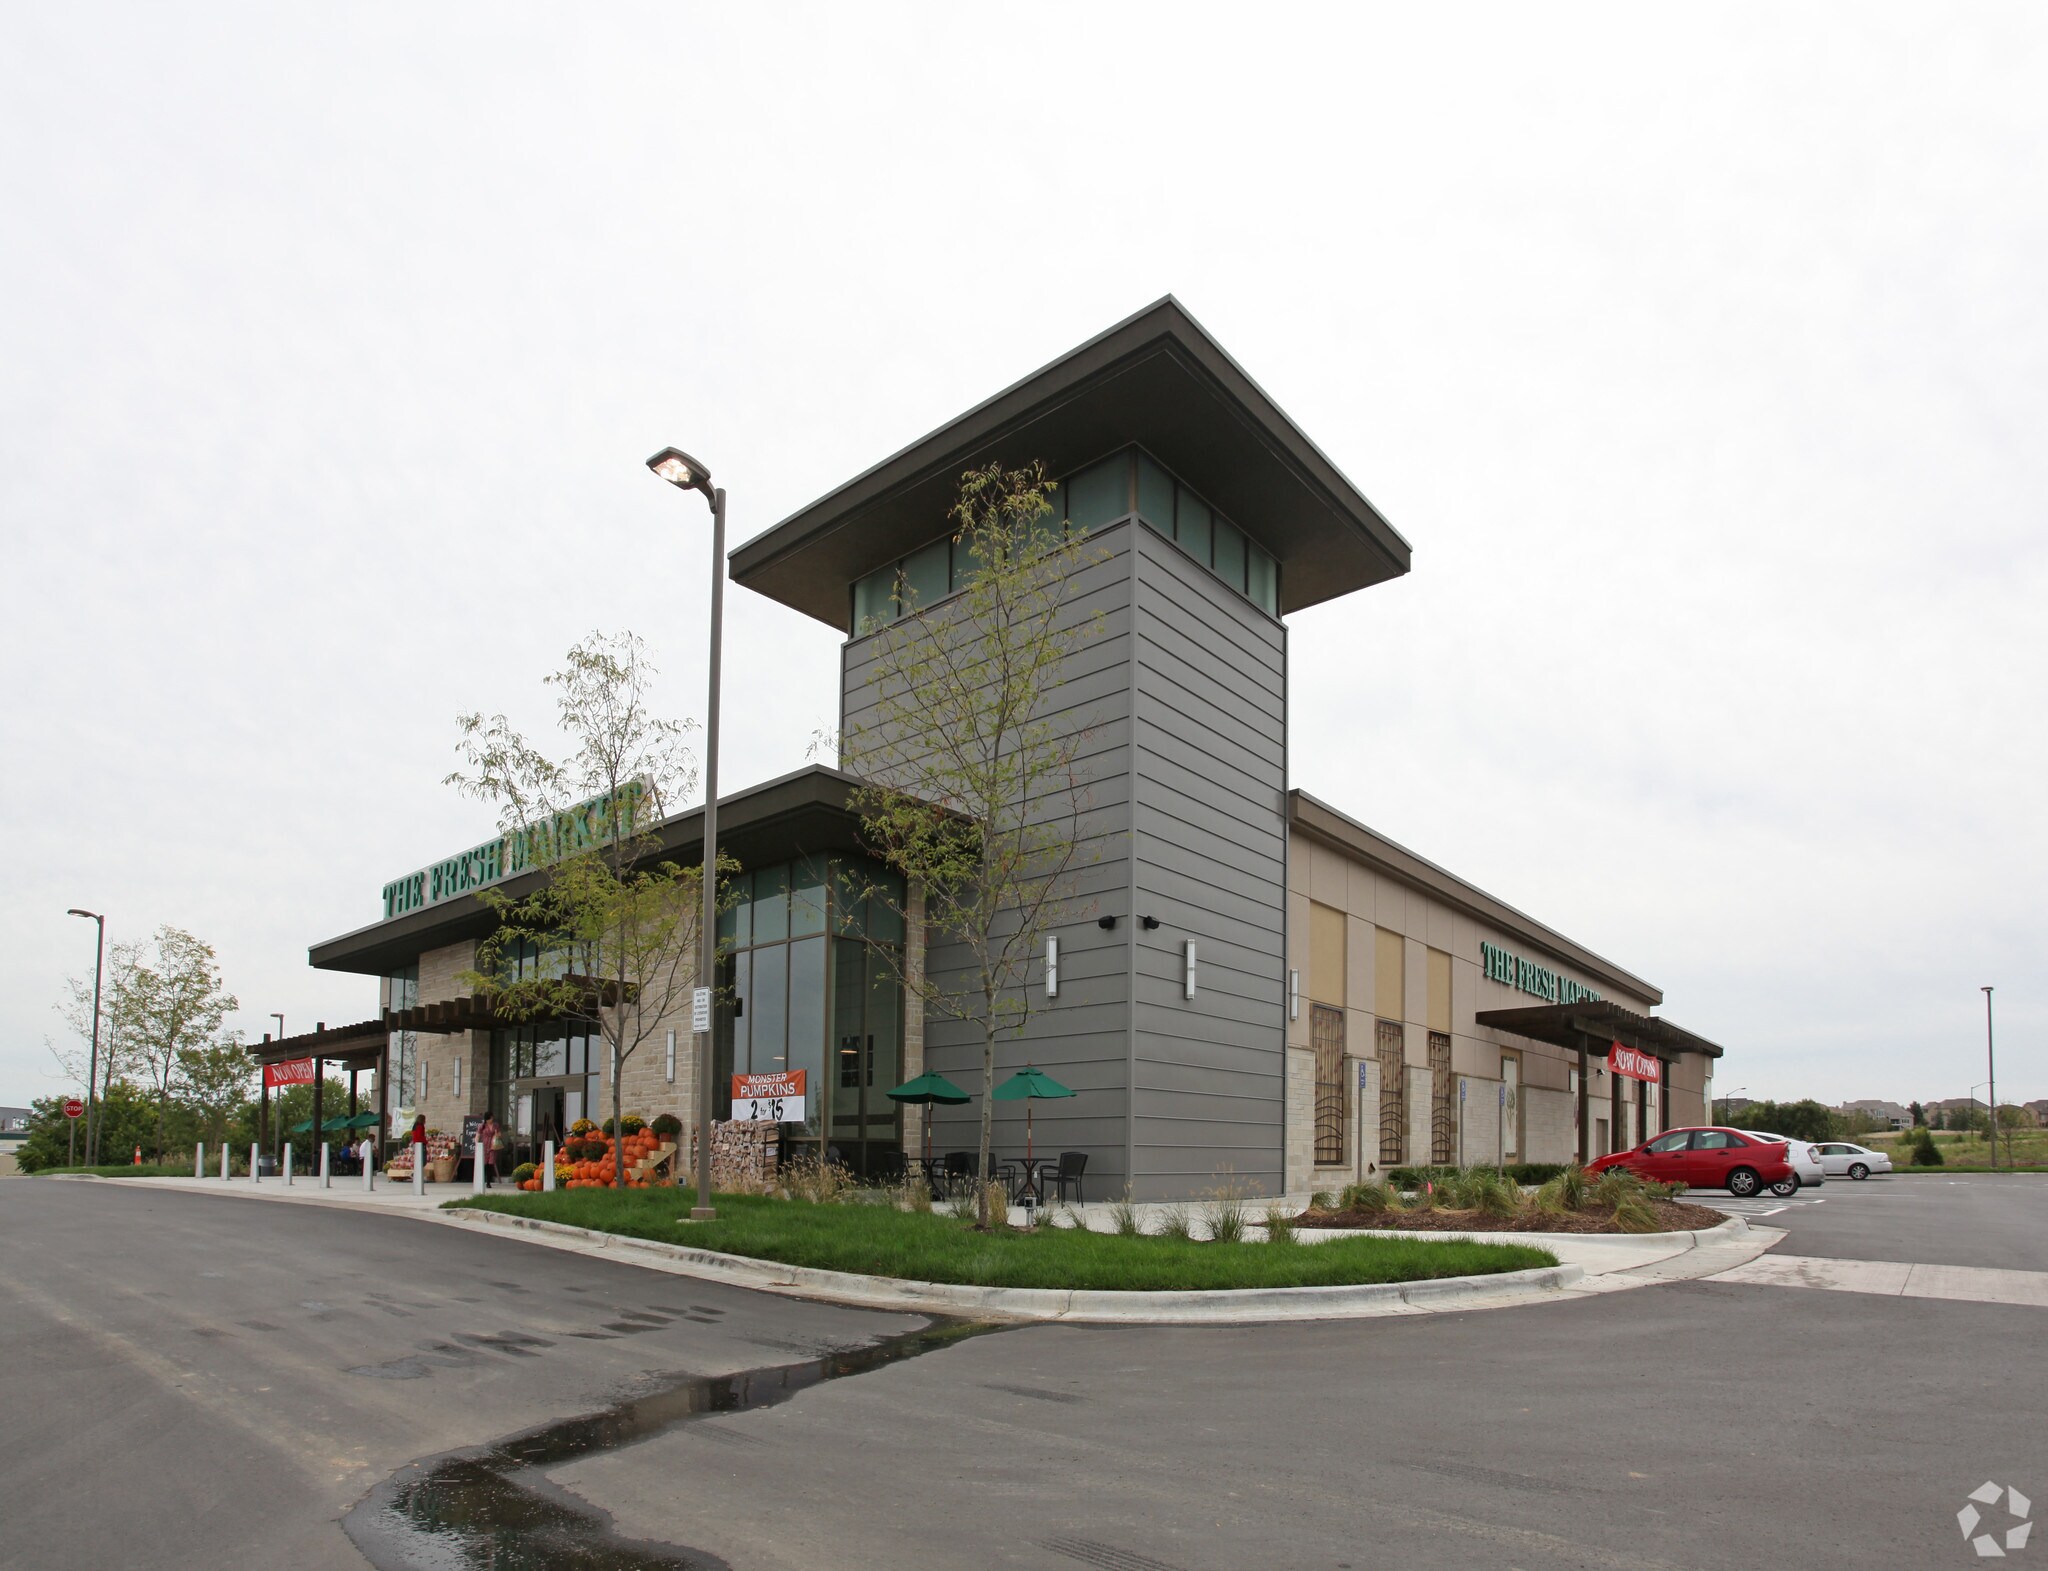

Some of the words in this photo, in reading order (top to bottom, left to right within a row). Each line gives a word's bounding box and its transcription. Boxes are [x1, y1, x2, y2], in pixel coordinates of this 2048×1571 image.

[383, 871, 424, 920] THE
[428, 838, 504, 905] FRESH
[1481, 941, 1513, 986] THE
[1515, 956, 1557, 1002] FRESH
[1613, 1047, 1635, 1072] NOW
[271, 1064, 294, 1082] NOW
[290, 1061, 313, 1080] OPEN
[747, 1072, 788, 1084] MONSTER
[740, 1082, 796, 1098] PUMPKINS
[750, 1099, 758, 1120] 2
